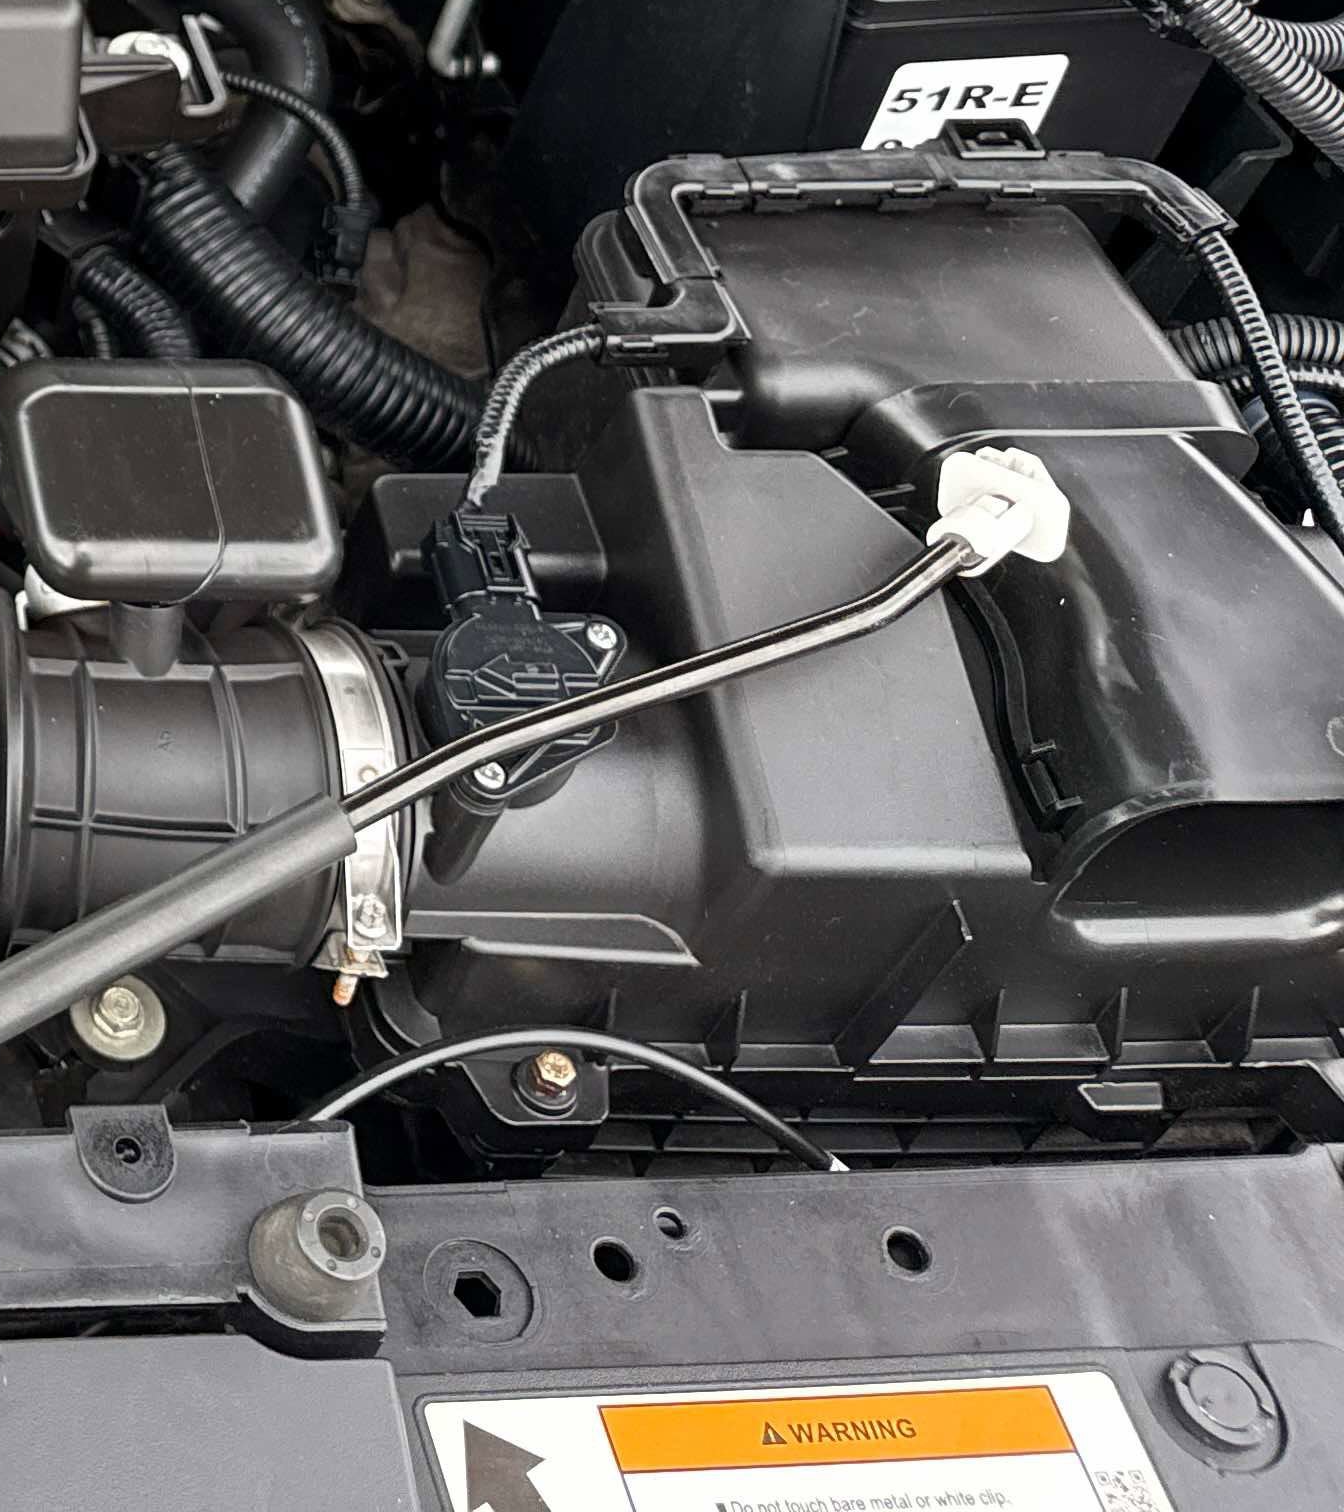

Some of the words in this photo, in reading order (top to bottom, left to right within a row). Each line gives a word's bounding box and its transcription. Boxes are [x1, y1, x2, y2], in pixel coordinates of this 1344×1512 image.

[886, 81, 1049, 113] 51R-E
[788, 1418, 918, 1444] WARNING
[785, 1497, 828, 1512] touch
[831, 1495, 866, 1511] bare
[870, 1492, 913, 1511] metal
[916, 1494, 932, 1508] or
[935, 1490, 976, 1507] white
